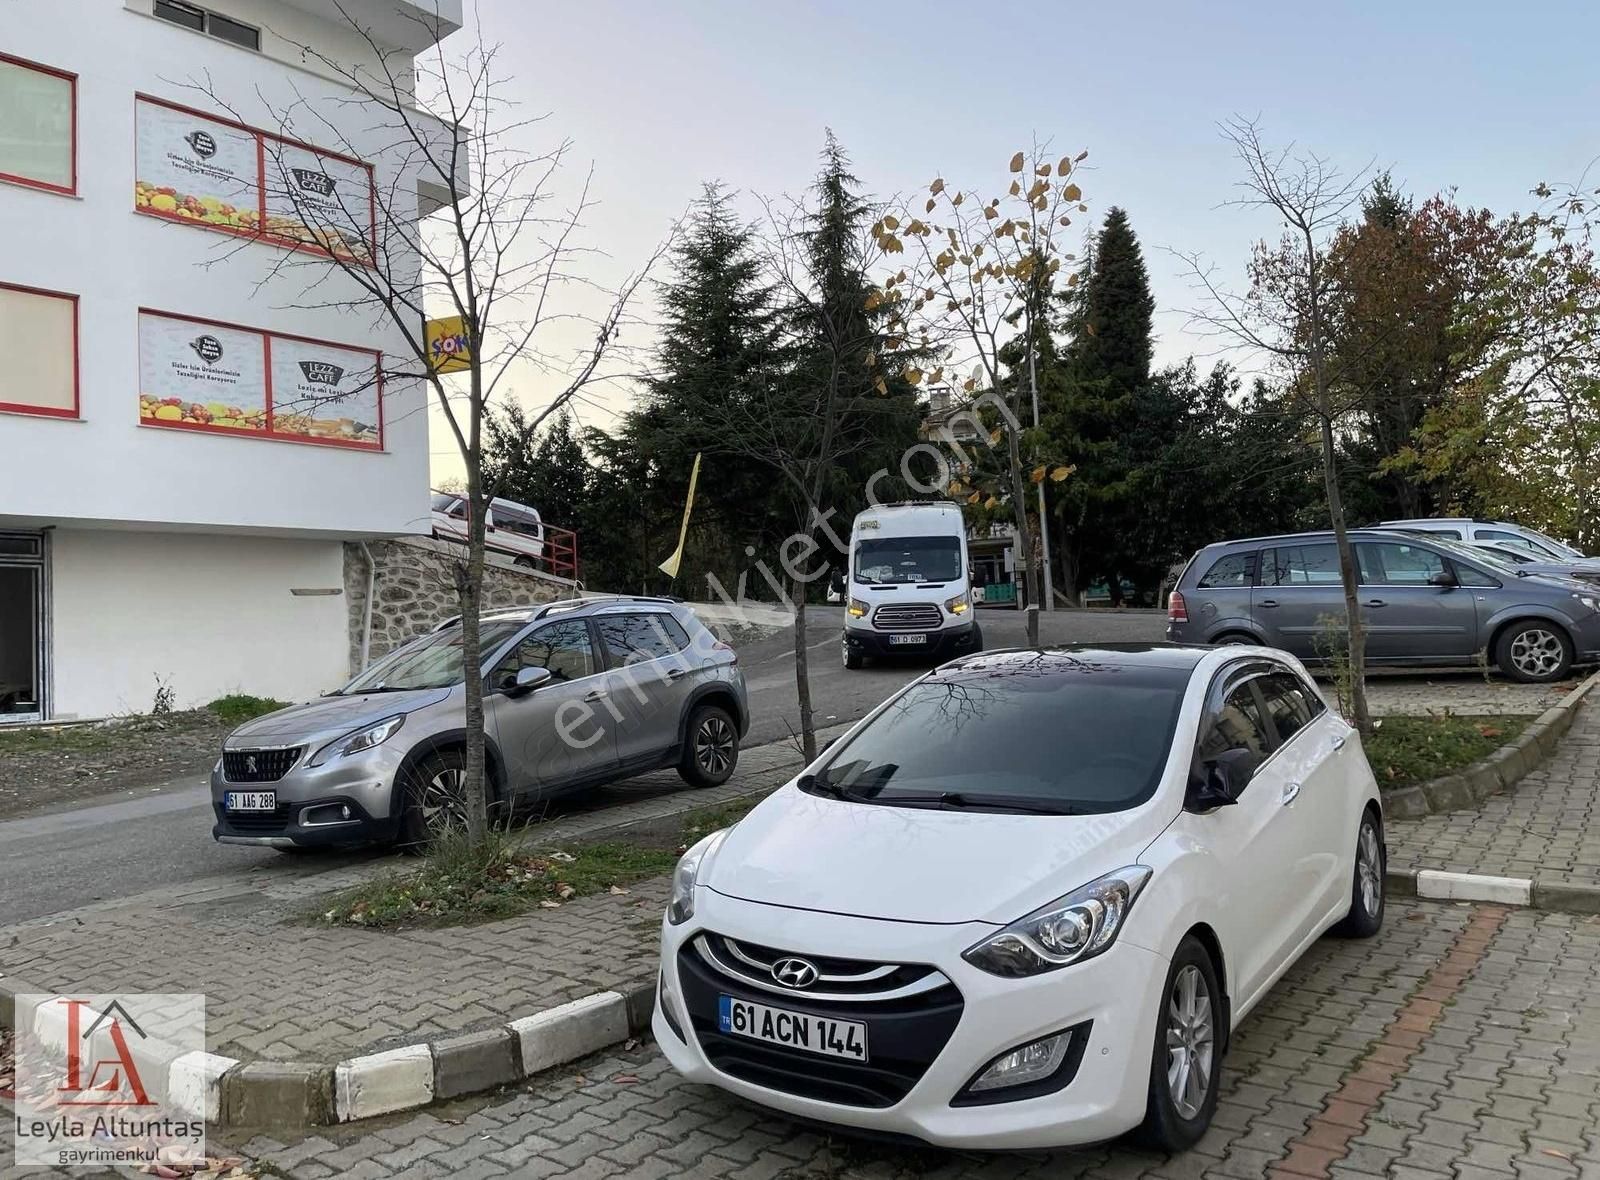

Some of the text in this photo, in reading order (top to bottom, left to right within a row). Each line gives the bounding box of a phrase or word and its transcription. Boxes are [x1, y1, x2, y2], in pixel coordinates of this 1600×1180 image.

[309, 363, 334, 373] LEZZ
[229, 794, 238, 808] 61
[259, 792, 274, 808] 288
[722, 1002, 864, 1057] TR 61 ACN 144
